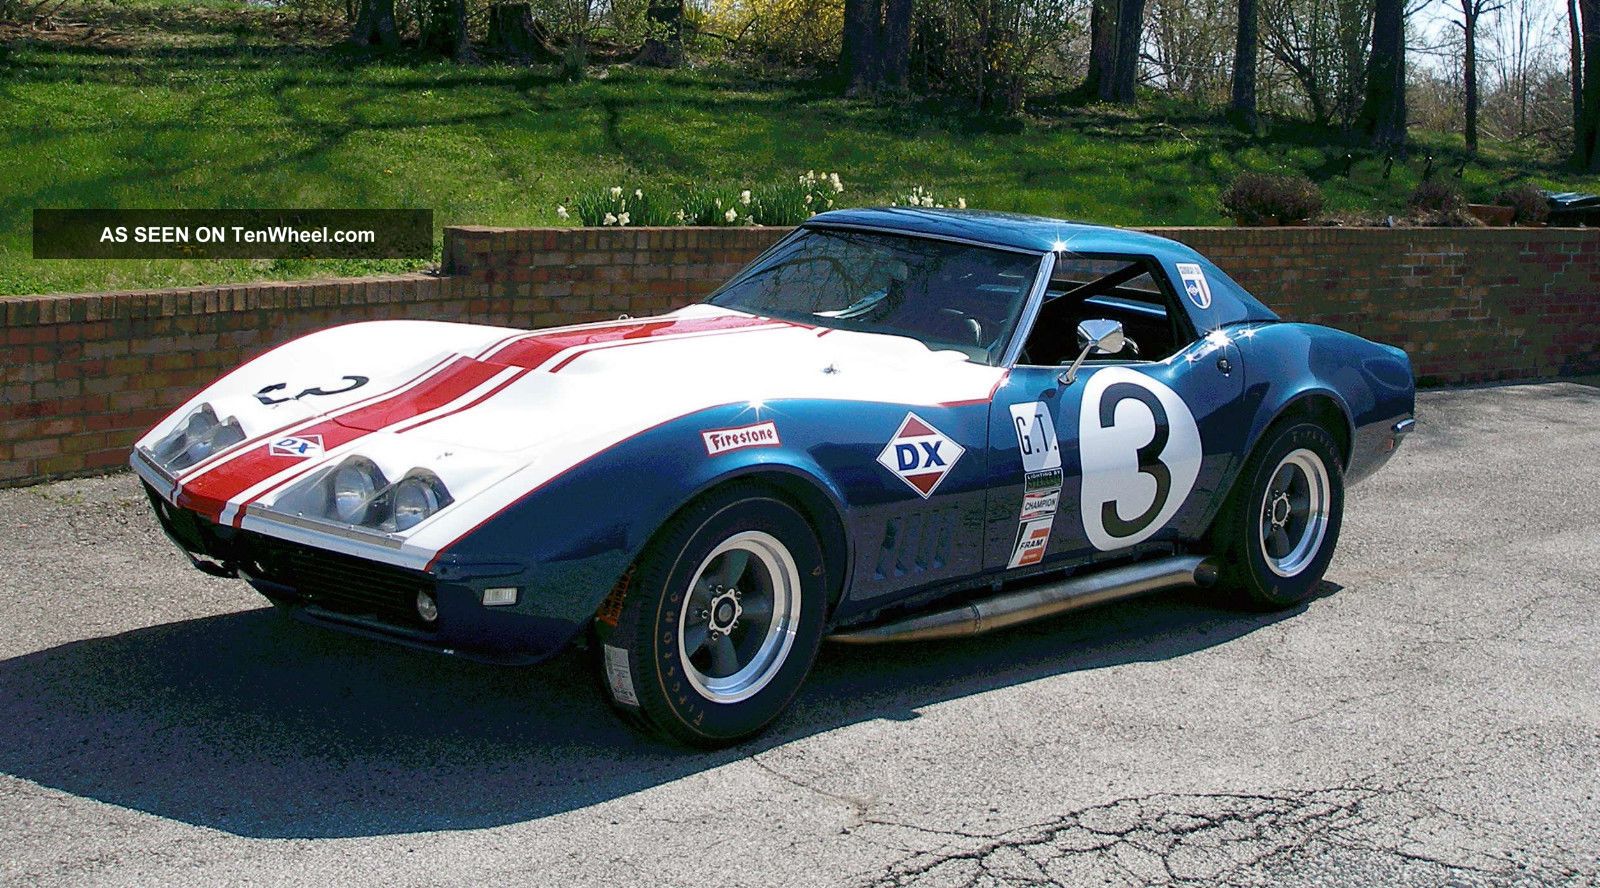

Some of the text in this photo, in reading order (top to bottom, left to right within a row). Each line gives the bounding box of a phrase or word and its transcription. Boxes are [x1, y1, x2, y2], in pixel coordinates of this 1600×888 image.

[253, 375, 370, 405] 3
[276, 438, 318, 455] DX
[708, 427, 774, 452] Firestone
[1015, 413, 1058, 456] G.T.
[894, 440, 948, 472] DX
[1099, 382, 1171, 538] 3
[1024, 498, 1057, 511] CHAMPION
[1019, 538, 1044, 550] FRAM
